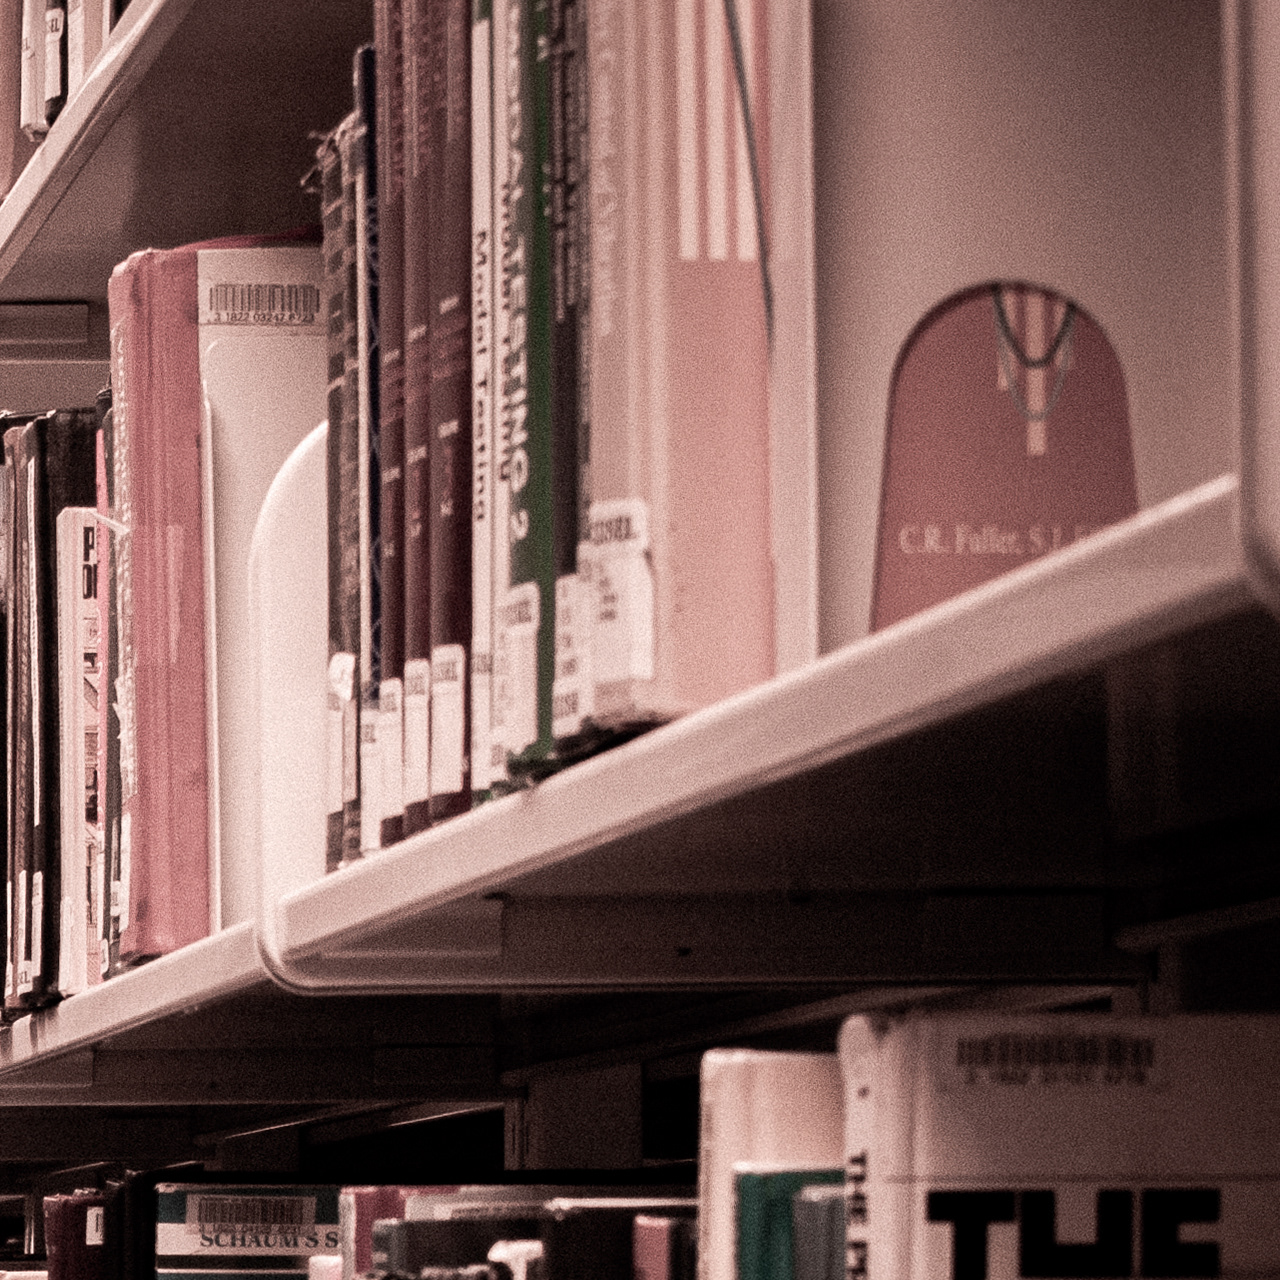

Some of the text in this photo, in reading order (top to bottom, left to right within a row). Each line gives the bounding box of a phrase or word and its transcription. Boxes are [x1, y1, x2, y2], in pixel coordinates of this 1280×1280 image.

[476, 230, 487, 522] Modal Testing
[508, 234, 528, 494] TESTING
[848, 1149, 867, 1225] THE
